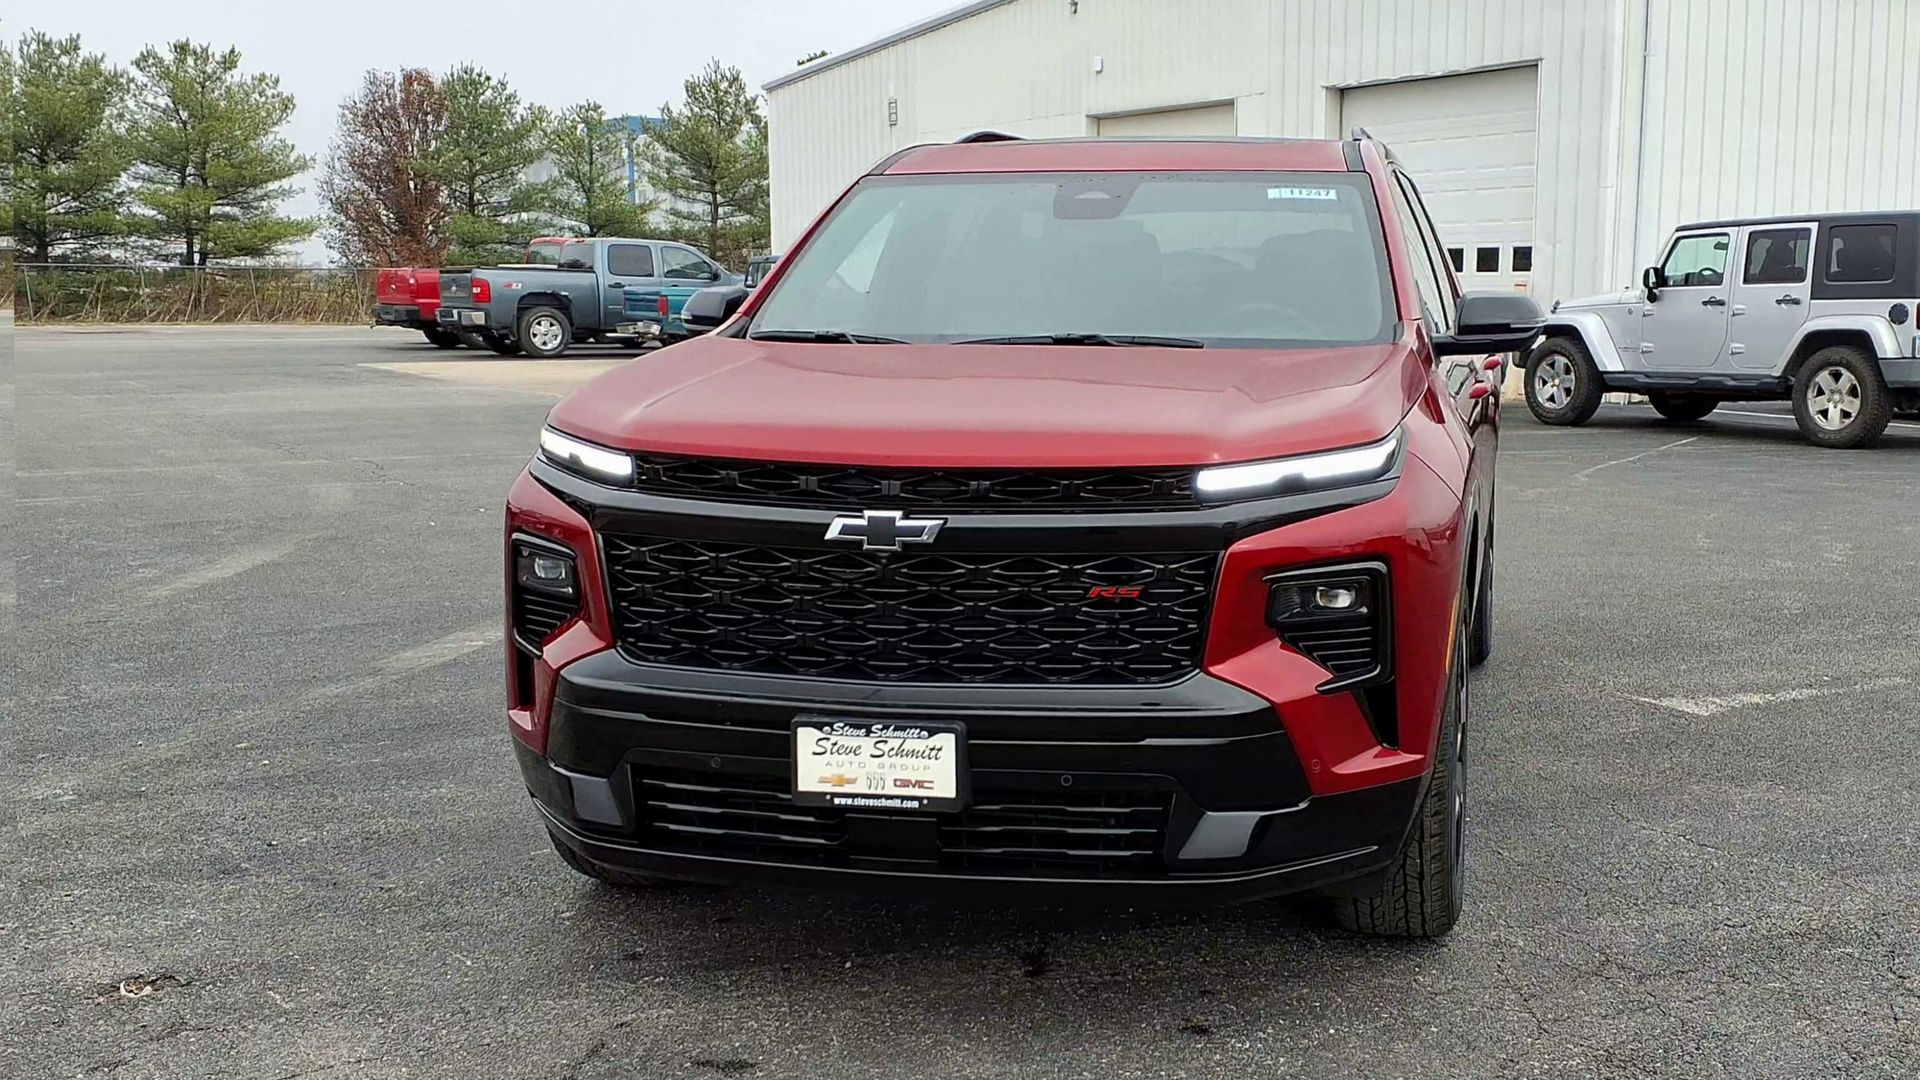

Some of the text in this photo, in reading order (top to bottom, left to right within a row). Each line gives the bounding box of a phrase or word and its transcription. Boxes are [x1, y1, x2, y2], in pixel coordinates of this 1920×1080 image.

[1089, 585, 1144, 598] RS
[832, 722, 920, 739] Steve Schmitt
[812, 737, 944, 761] Steve Schmitt
[825, 760, 931, 772] AUTO GROUP
[893, 777, 934, 790] GMC
[833, 796, 920, 808] www.steveschmitt.com
